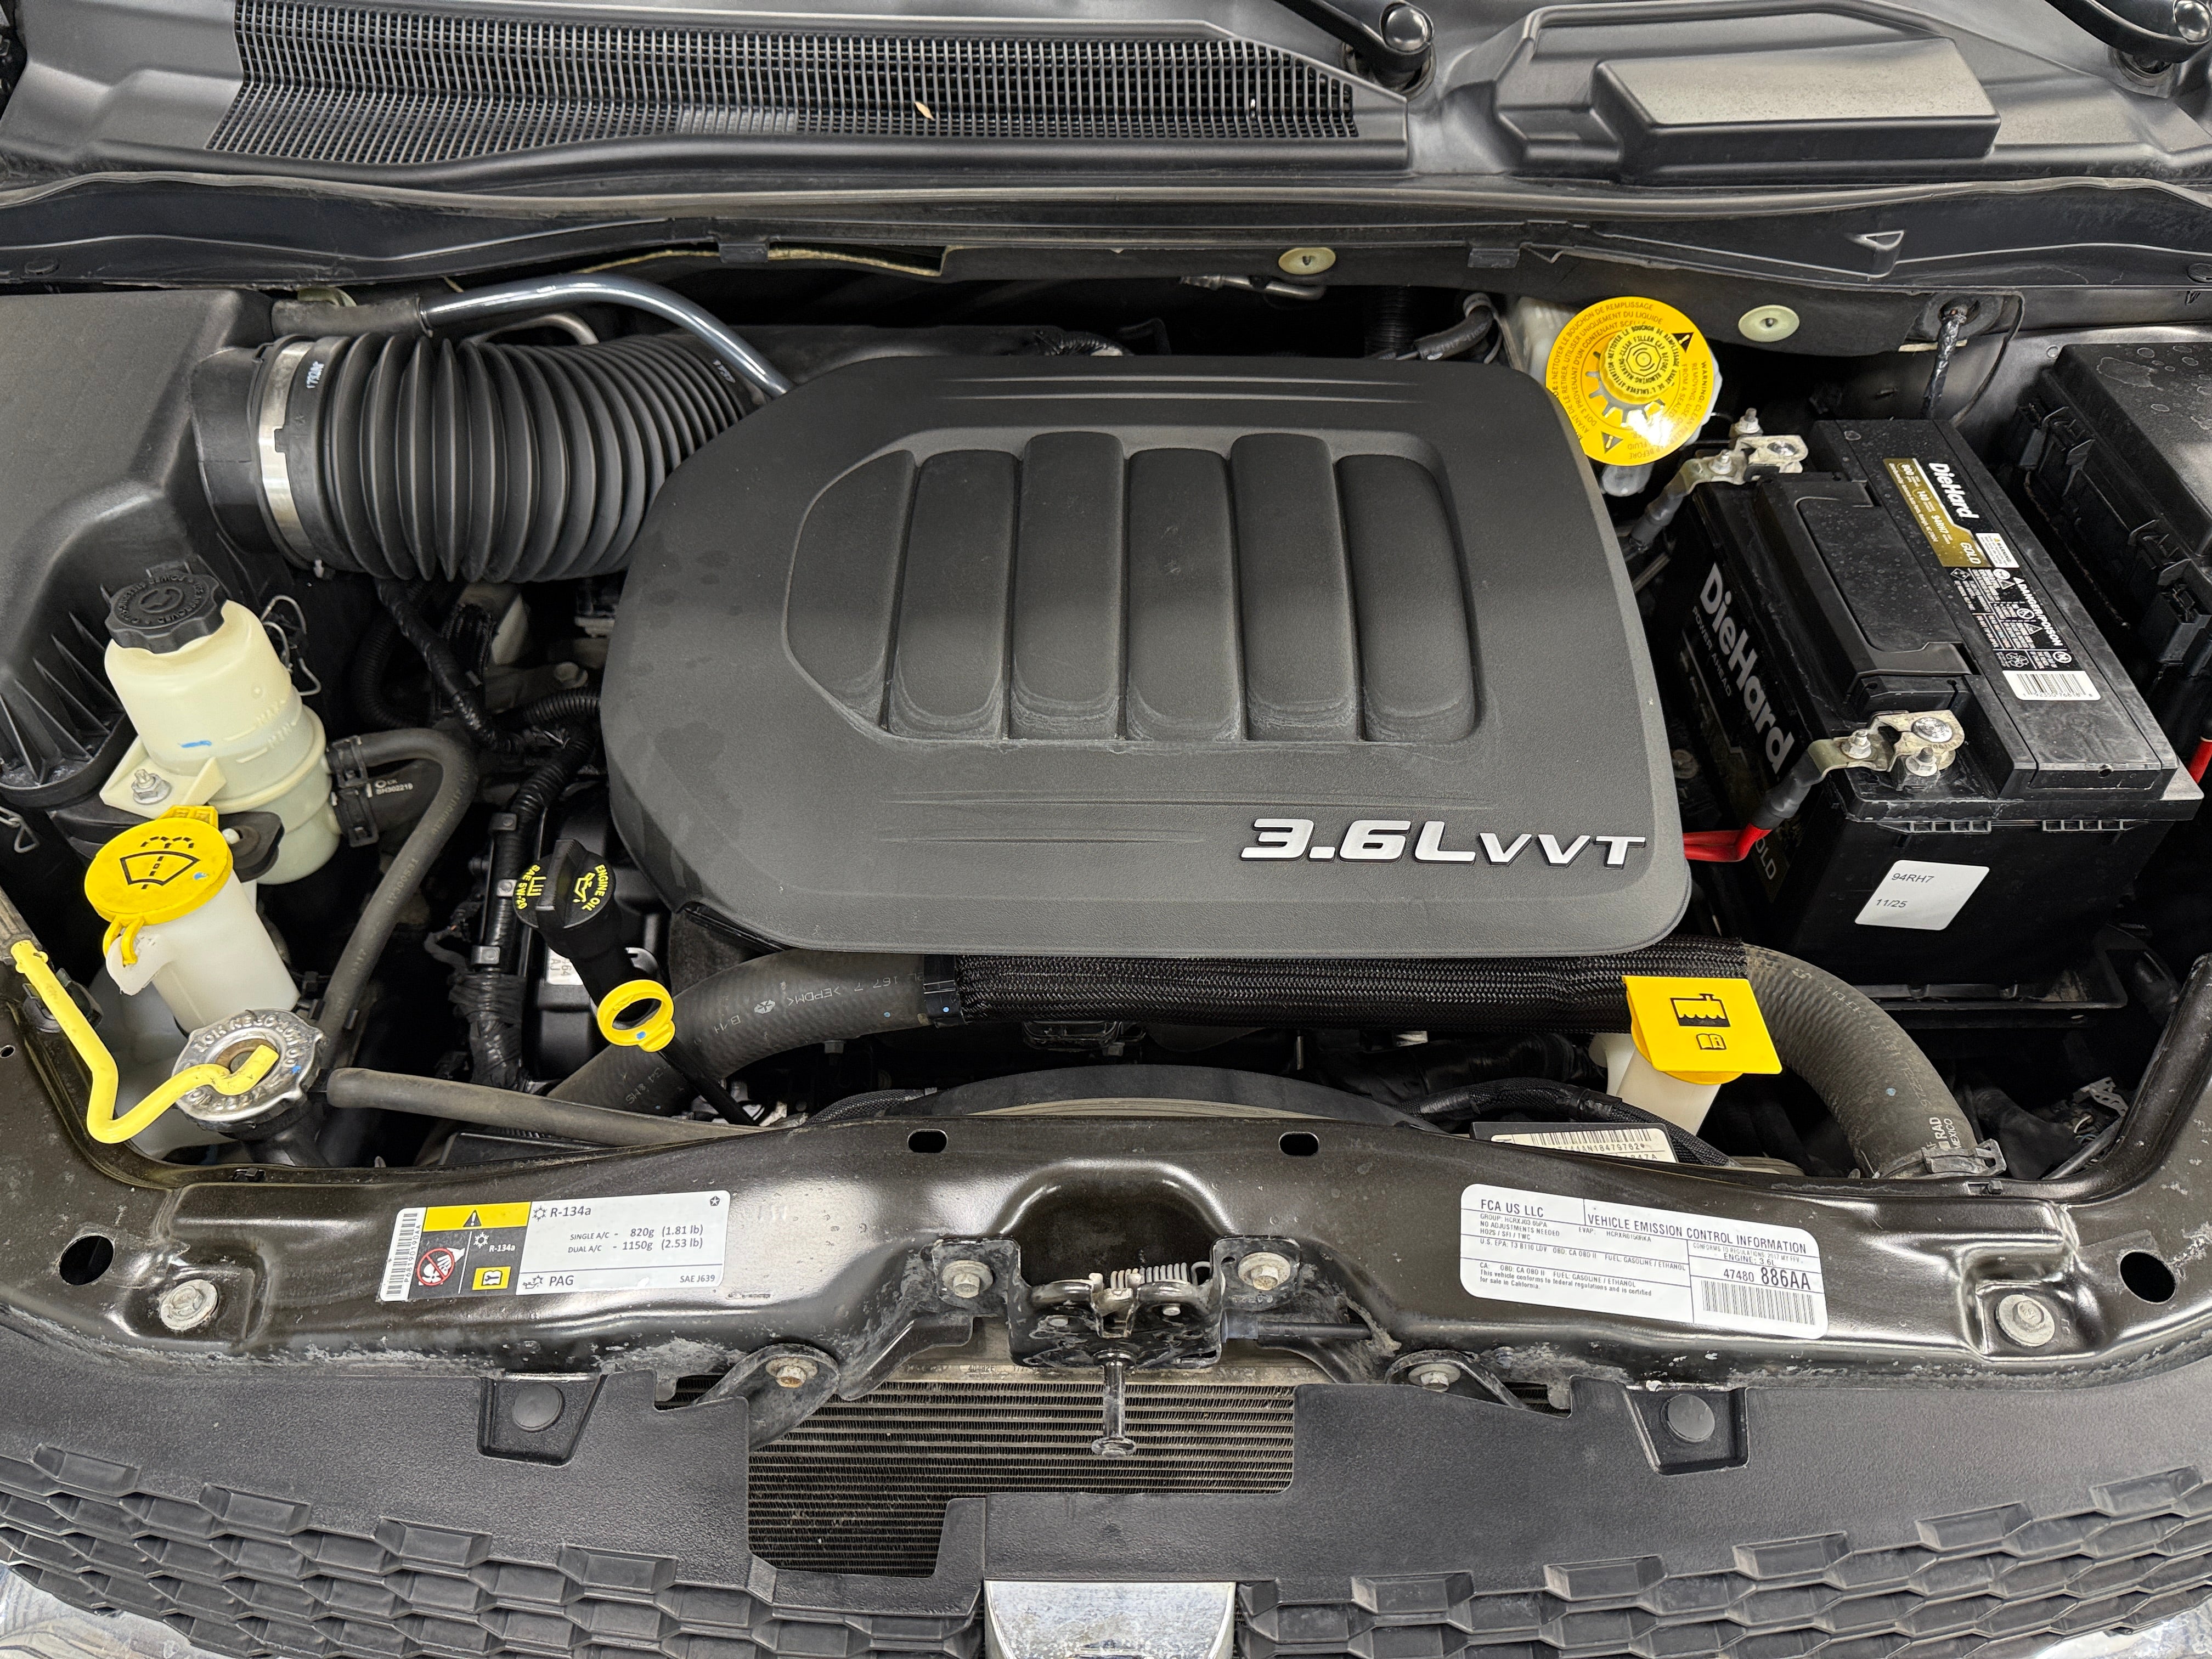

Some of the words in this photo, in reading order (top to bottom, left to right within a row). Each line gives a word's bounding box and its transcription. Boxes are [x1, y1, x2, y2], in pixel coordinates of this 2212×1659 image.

[1566, 312, 1595, 338] BOUCHON
[1595, 306, 1605, 315] DE
[1579, 311, 1622, 337] UNIQUEMENT
[1635, 311, 1663, 325] LIQUIDE
[1582, 323, 1618, 348] CONTENANT
[1655, 339, 1666, 349] CAP
[1584, 415, 1598, 427] DOT
[1928, 462, 1980, 518] DieHard
[1960, 542, 1982, 565] GOLD
[2017, 583, 2063, 647] DANGER/POISON
[1692, 606, 1712, 651] POWER
[1711, 652, 1732, 697] AHEAD
[1700, 562, 1795, 775] DieHard
[1240, 818, 1476, 865] 3.6L
[1756, 838, 1776, 880] OLD
[522, 864, 541, 882] SAE
[594, 864, 610, 898] ENGINE
[1891, 873, 1935, 883] 94RH7
[515, 882, 528, 911] 5W-20
[581, 896, 601, 912] OIL
[1875, 898, 1908, 909] 11/25
[1929, 1116, 1948, 1140] RAD
[1943, 1118, 1962, 1150] MEXICO
[550, 1206, 591, 1217] R-134a
[1481, 1199, 1501, 1212] FCA
[1506, 1203, 1520, 1214] US
[1524, 1206, 1544, 1218] LLC
[630, 1227, 654, 1239] 820g
[662, 1226, 688, 1237] (1.81
[690, 1224, 703, 1235] lb)
[1491, 1222, 1534, 1234] ADJUSTMENTS
[1536, 1228, 1560, 1237] NEEDED
[1587, 1214, 1630, 1229] VEHICLE
[1634, 1220, 1683, 1237] EMISSION
[1686, 1228, 1733, 1245] CONTROL
[1736, 1234, 1806, 1254] INFORMATION
[489, 1244, 516, 1253] R-134a
[622, 1240, 653, 1251] 1150g
[661, 1239, 687, 1250] (2.53
[690, 1237, 703, 1249] lb)
[1624, 1256, 1654, 1267] GASOLINE
[1658, 1260, 1686, 1271] ETHANOL
[1724, 1252, 1758, 1265] ENGINE:
[549, 1275, 574, 1286] PAG
[696, 1274, 715, 1283] J639
[1494, 1272, 1515, 1280] vehicle
[1516, 1273, 1544, 1283] conforms
[1553, 1278, 1573, 1286] federal
[1574, 1281, 1607, 1293] regulations
[1628, 1288, 1652, 1296] certified
[1572, 1272, 1602, 1283] GASOLINE
[1608, 1277, 1637, 1287] ETHANOL
[1723, 1268, 1754, 1282] 47480
[1760, 1266, 1811, 1290] 886AA
